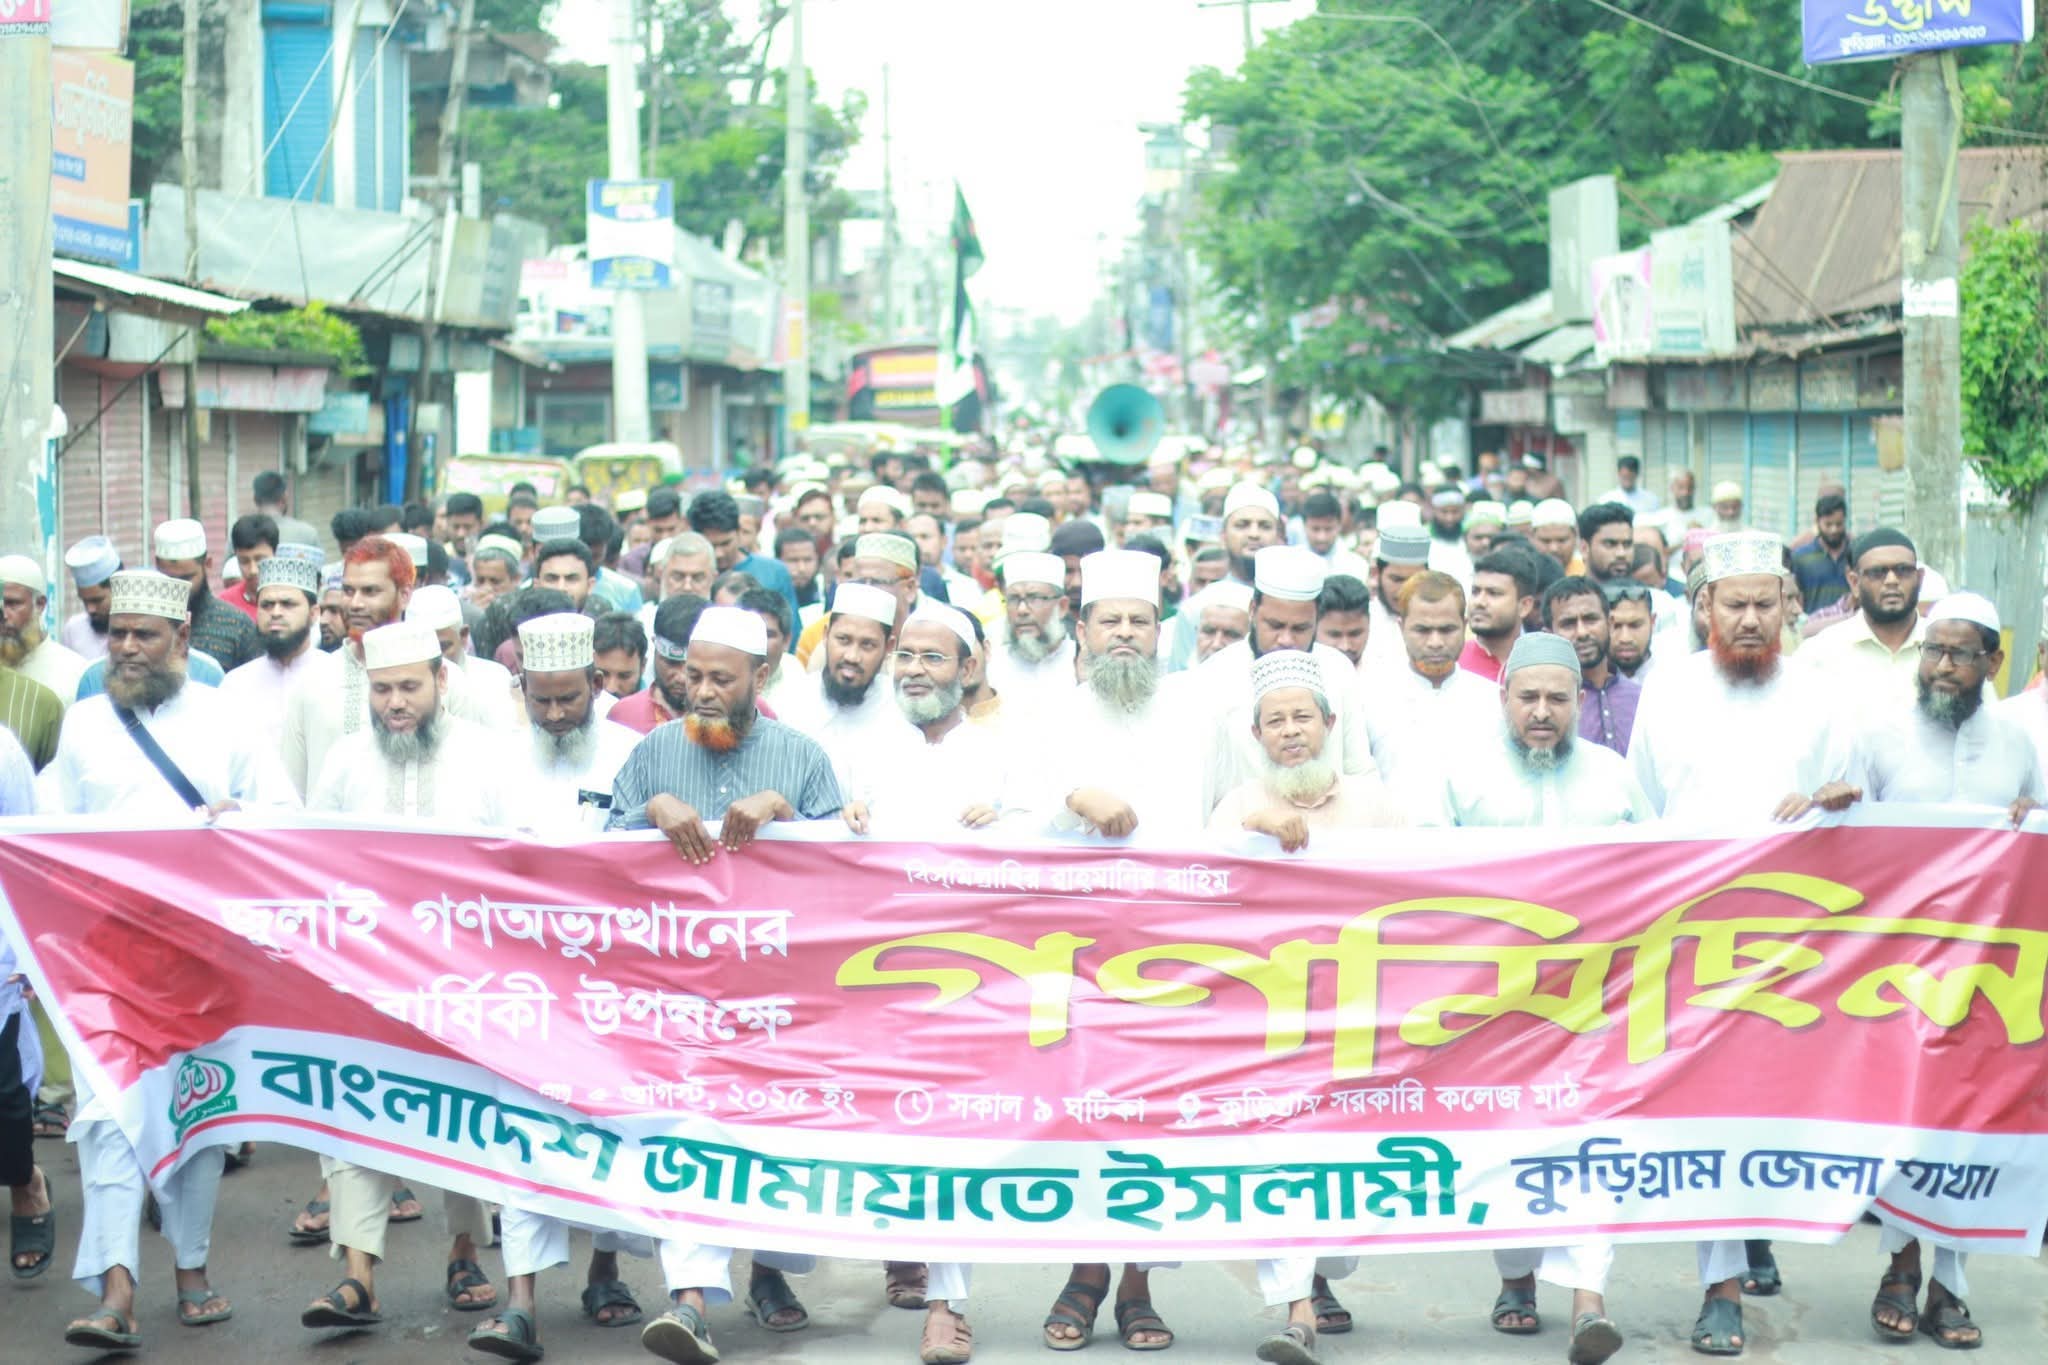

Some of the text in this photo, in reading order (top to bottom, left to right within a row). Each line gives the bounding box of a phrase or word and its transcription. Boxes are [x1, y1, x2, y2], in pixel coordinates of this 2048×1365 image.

[411, 892, 795, 966] গণঅভ্যুত্থানের
[573, 973, 798, 1043] উপলক্ষে
[728, 1083, 811, 1113] ২০২৫
[818, 1082, 859, 1118] ইং
[946, 1092, 1025, 1122] সকাল
[1062, 1088, 1148, 1123] ঘটিকা
[1330, 1078, 1427, 1115] সরকারি
[1433, 1083, 1523, 1114] কলেজ
[1530, 1072, 1582, 1112] মাঠ
[251, 1049, 623, 1181] বাংলাদেশ
[640, 1134, 1081, 1230] জামায়াতে
[1099, 1136, 1489, 1232] ইসলামী,
[1510, 1136, 1726, 1216] কুড়িগ্রাম
[1739, 1149, 1885, 1197] জেলা
